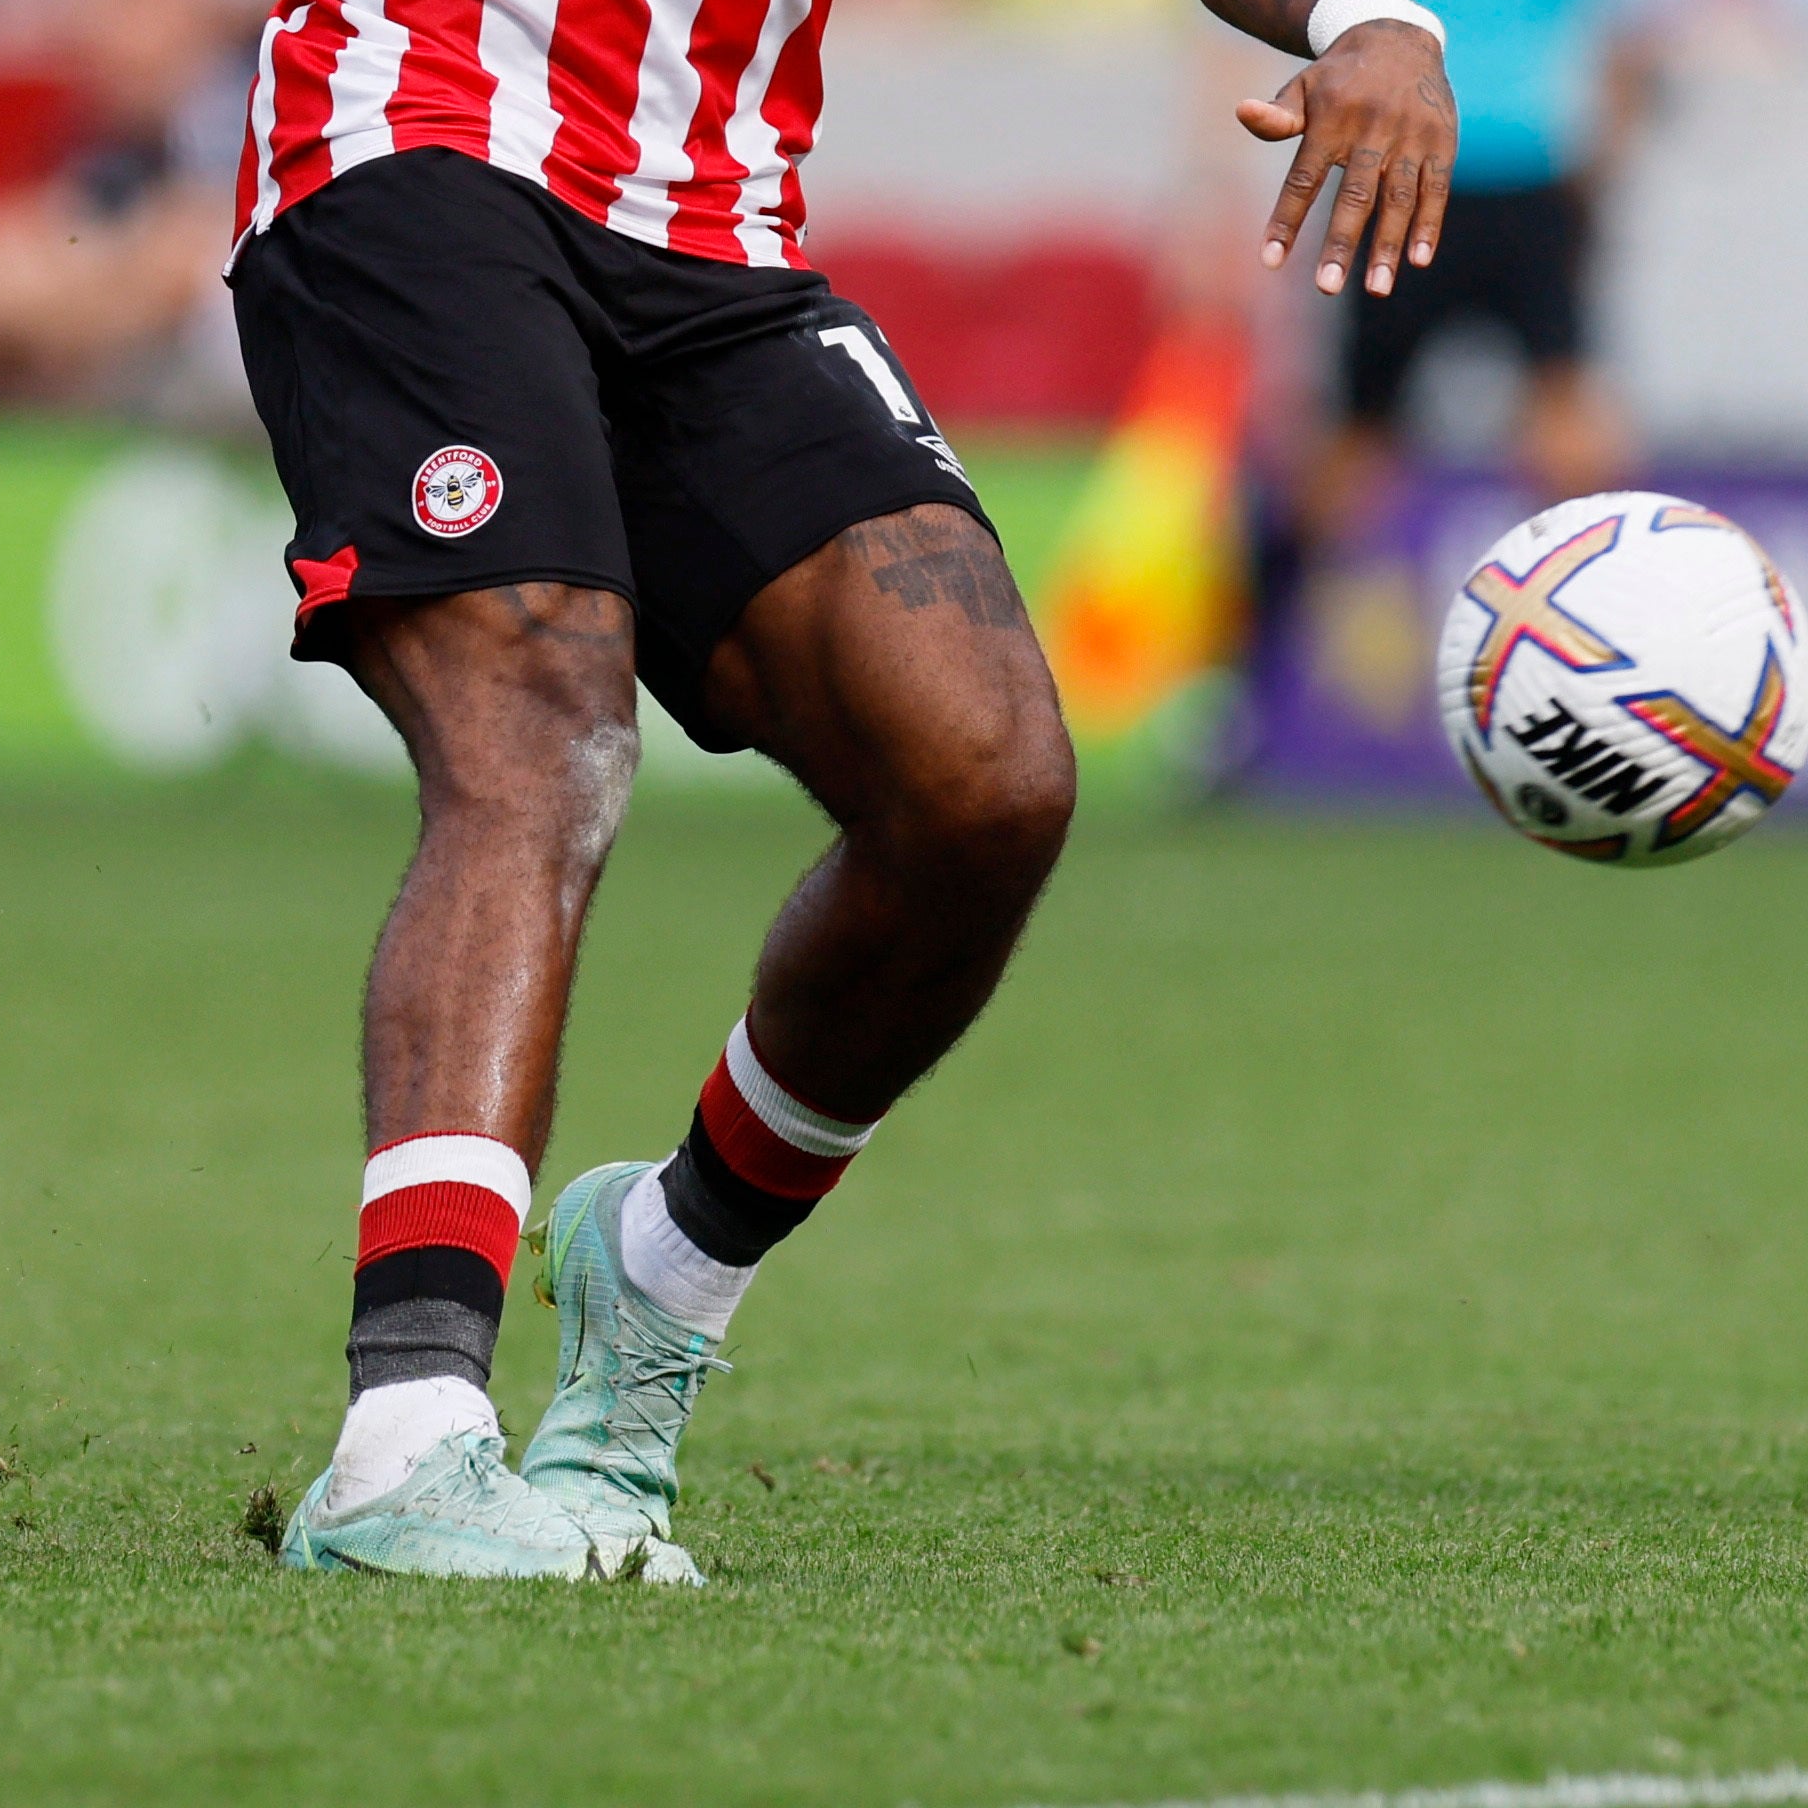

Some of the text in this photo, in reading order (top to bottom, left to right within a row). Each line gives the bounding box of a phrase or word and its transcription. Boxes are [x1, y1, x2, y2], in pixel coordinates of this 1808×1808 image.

[420, 450, 483, 484] BRENTFORD
[426, 502, 492, 532] FOOTBALL CLUB
[1504, 697, 1670, 816] NIKE
